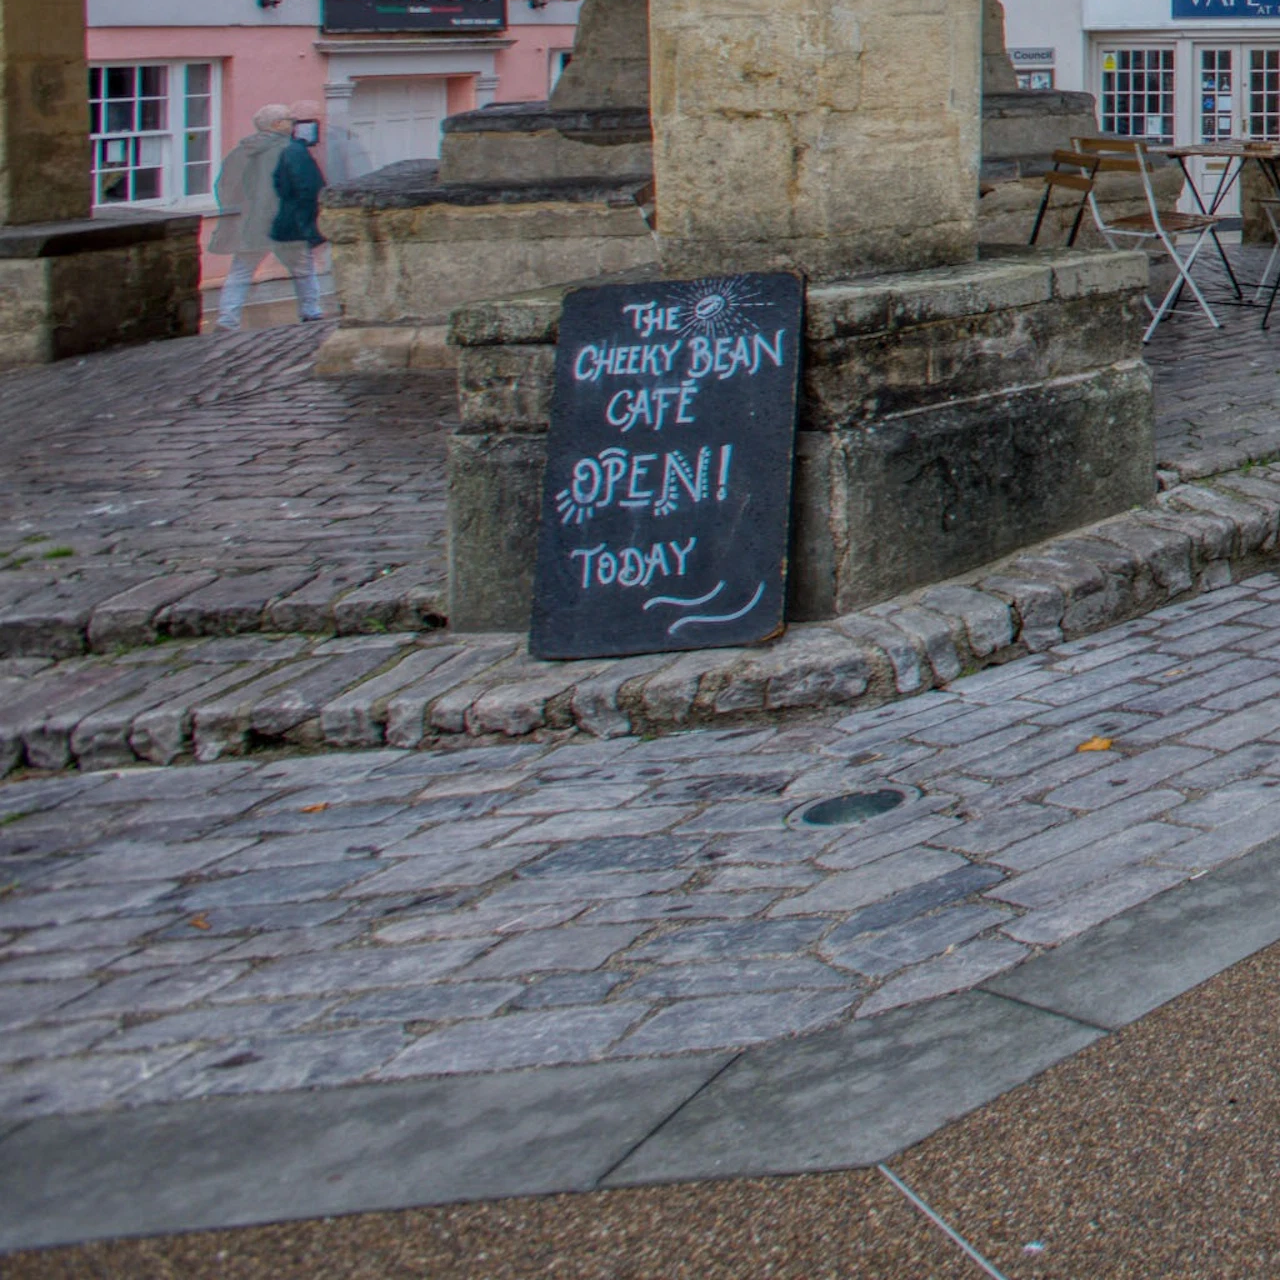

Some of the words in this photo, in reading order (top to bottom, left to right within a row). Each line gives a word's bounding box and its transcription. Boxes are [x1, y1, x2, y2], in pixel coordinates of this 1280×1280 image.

[1257, 5, 1272, 15] AT
[1013, 50, 1054, 60] Council
[622, 301, 681, 337] THE
[574, 339, 682, 381] CHEEKY
[687, 329, 786, 379] BEAN
[571, 445, 732, 511] OPEN!
[571, 536, 698, 589] TODAY
